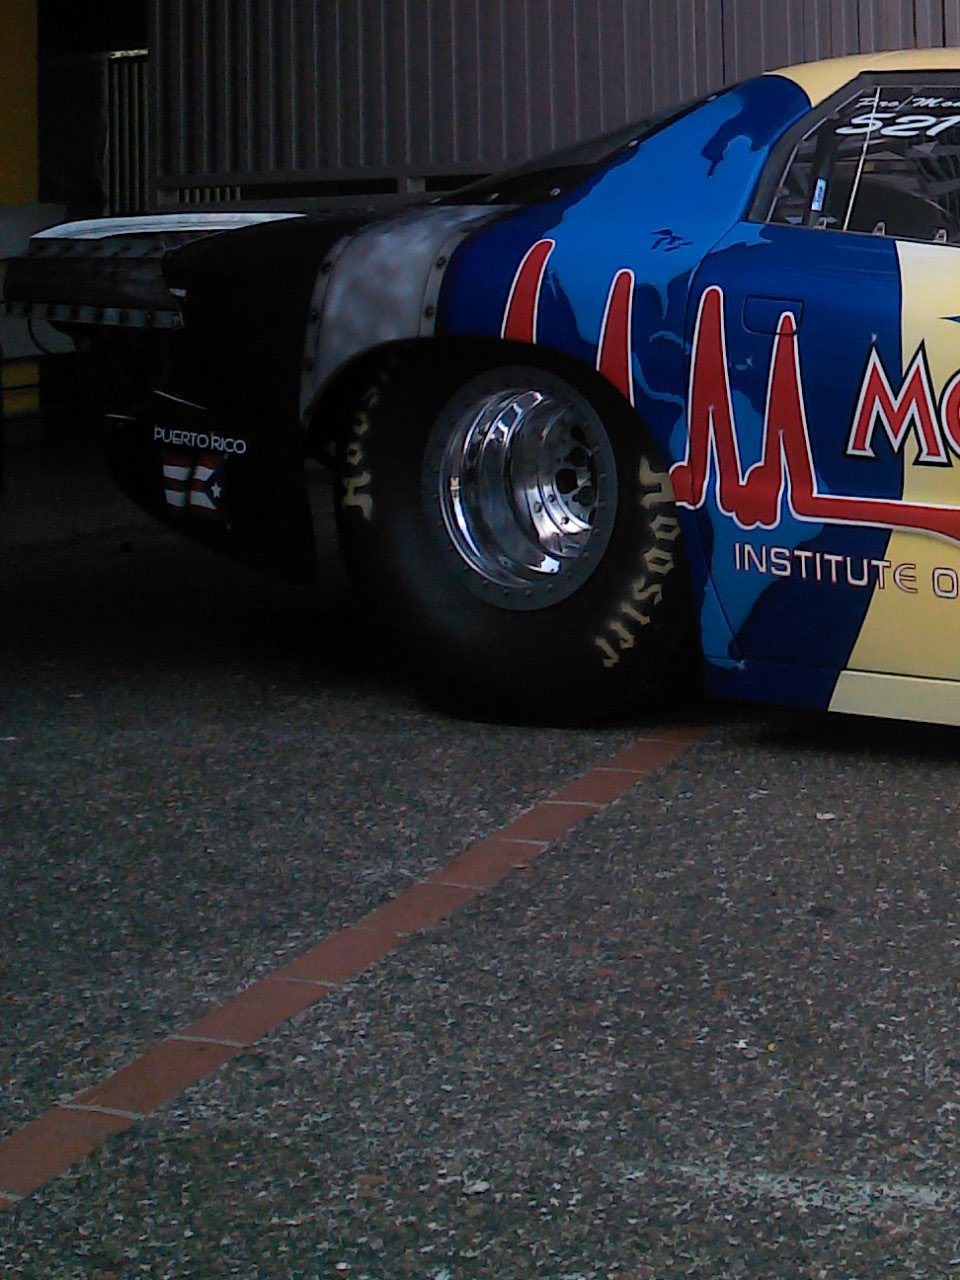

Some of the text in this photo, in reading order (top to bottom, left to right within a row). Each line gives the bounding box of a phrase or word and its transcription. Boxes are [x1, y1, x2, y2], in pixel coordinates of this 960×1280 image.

[154, 426, 247, 454] PUERTO RICO
[734, 542, 918, 594] INSTITUTE
